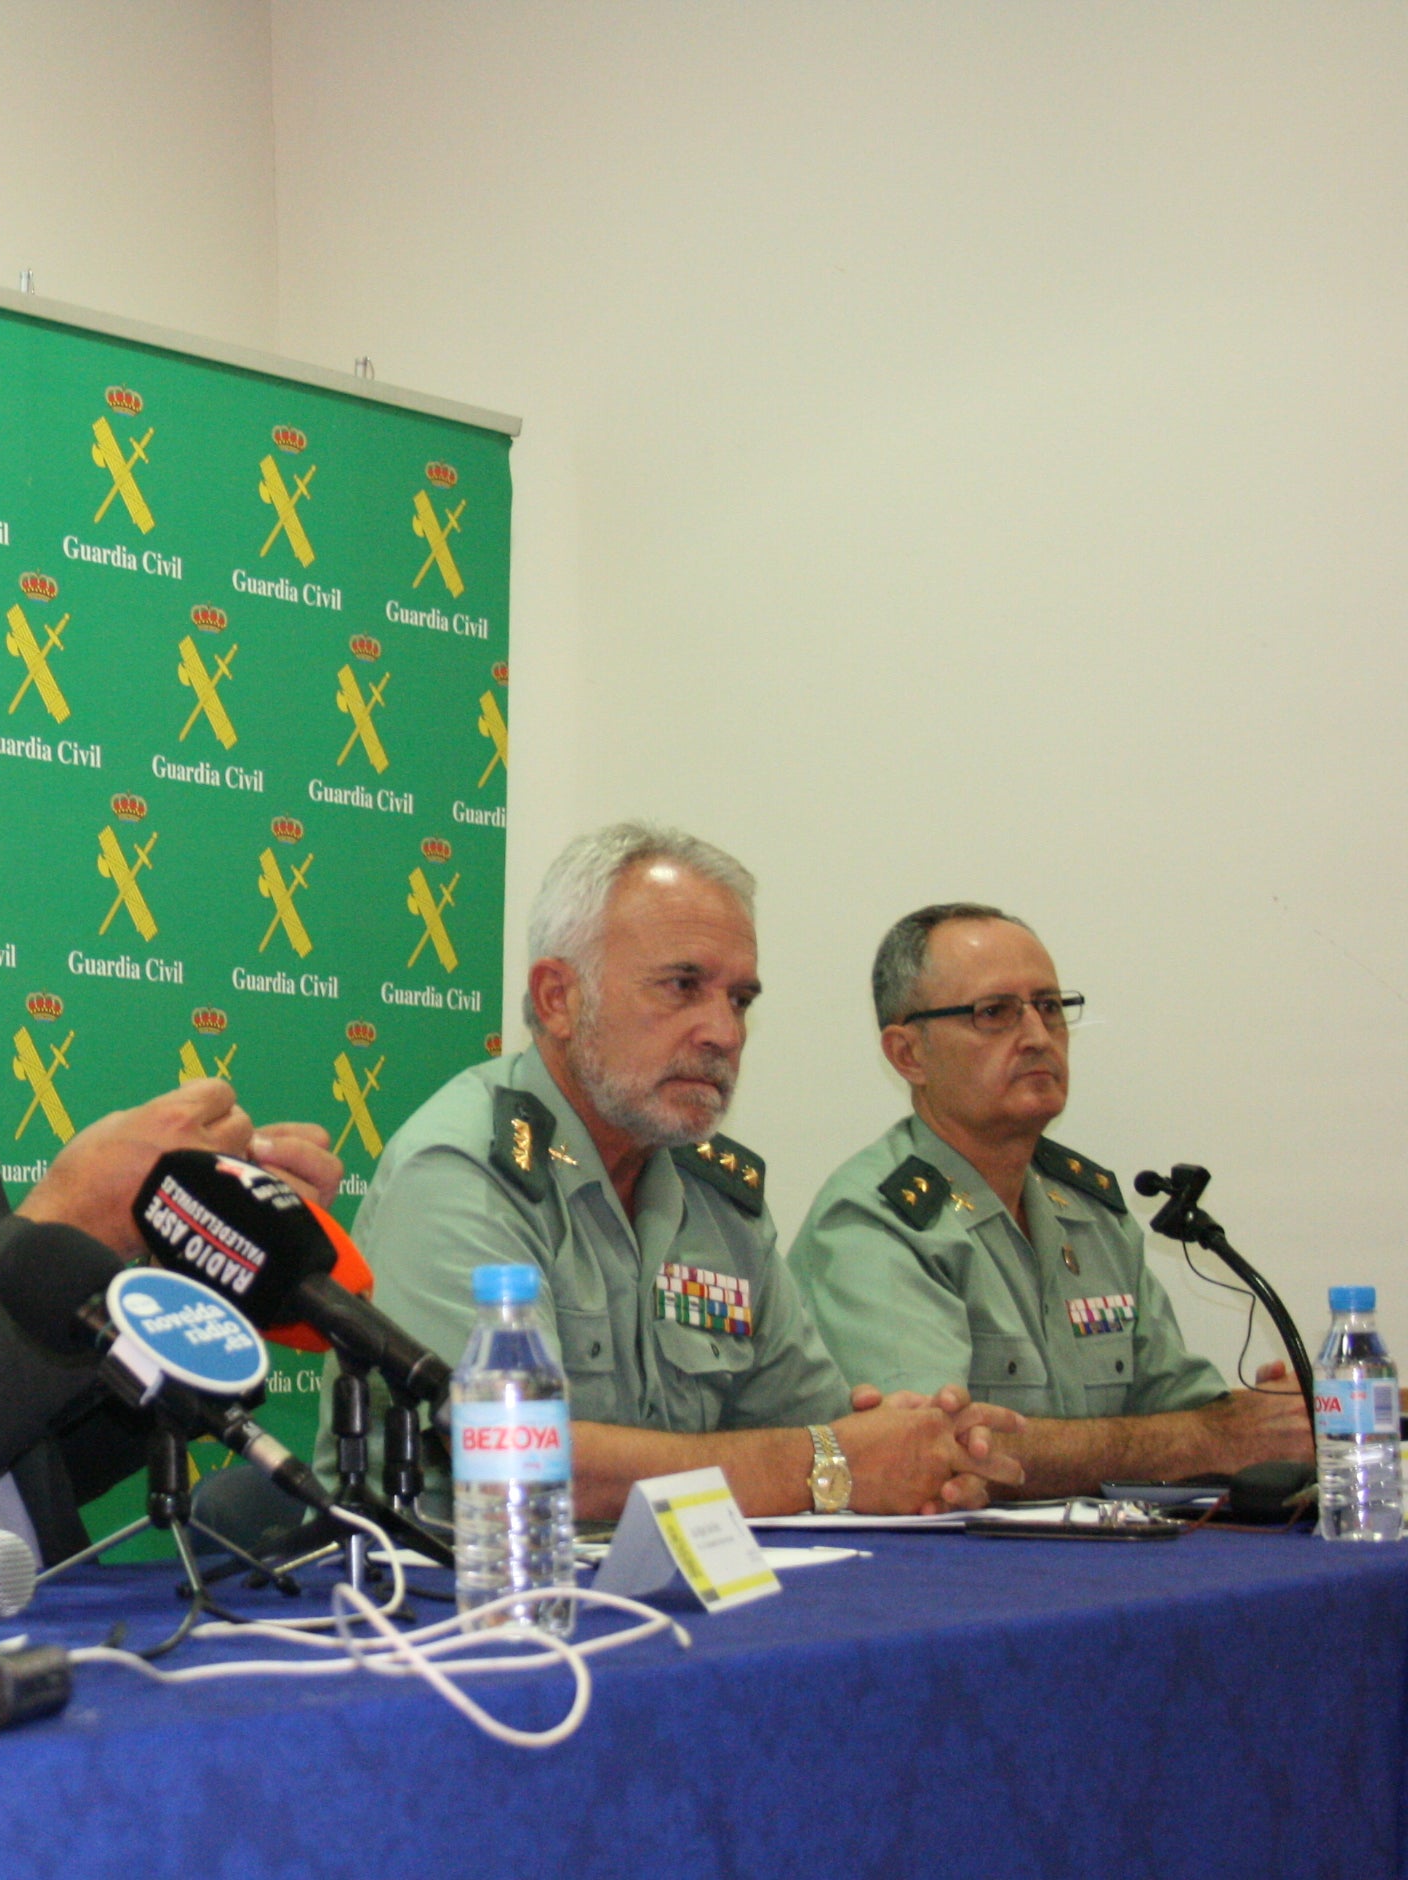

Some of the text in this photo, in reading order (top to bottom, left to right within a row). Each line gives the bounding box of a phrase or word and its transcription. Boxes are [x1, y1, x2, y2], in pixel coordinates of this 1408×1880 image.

[63, 536, 182, 579] Guardia Civil
[232, 569, 341, 610] Guardia Civil
[386, 600, 488, 639] Guardia Civil
[58, 741, 101, 768] Civil
[152, 755, 263, 792] Guardia Civil
[309, 779, 413, 814] Guardia Civil
[453, 801, 506, 828] Guardi
[68, 951, 183, 983] Guardia Civil
[232, 967, 338, 998] Guardia Civil
[381, 982, 480, 1011] Guardia Civil
[145, 1195, 189, 1245] ASPE
[185, 1235, 254, 1294] RADIO
[463, 1426, 560, 1451] BEZOYA
